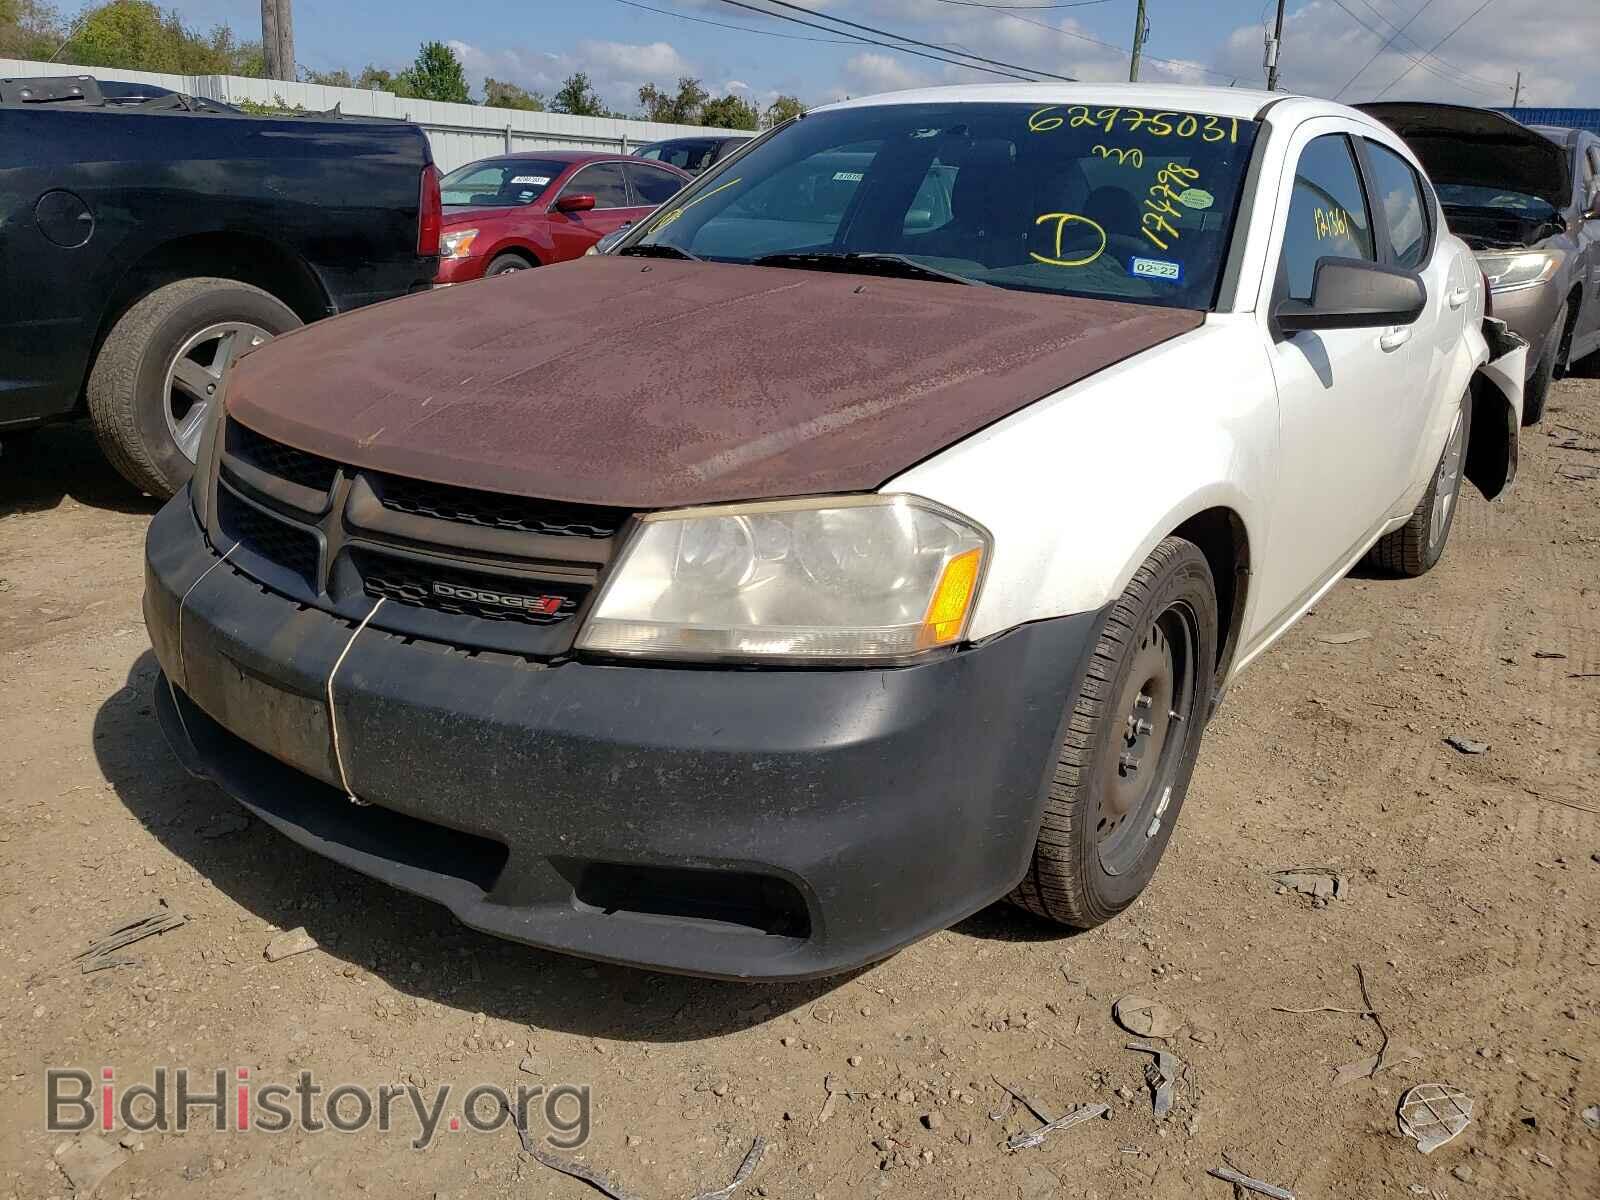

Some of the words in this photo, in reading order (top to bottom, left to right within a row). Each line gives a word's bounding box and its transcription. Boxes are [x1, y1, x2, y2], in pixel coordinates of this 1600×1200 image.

[1028, 105, 1239, 144] 62975031
[1029, 212, 1107, 266] D
[434, 582, 546, 610] DODGE
